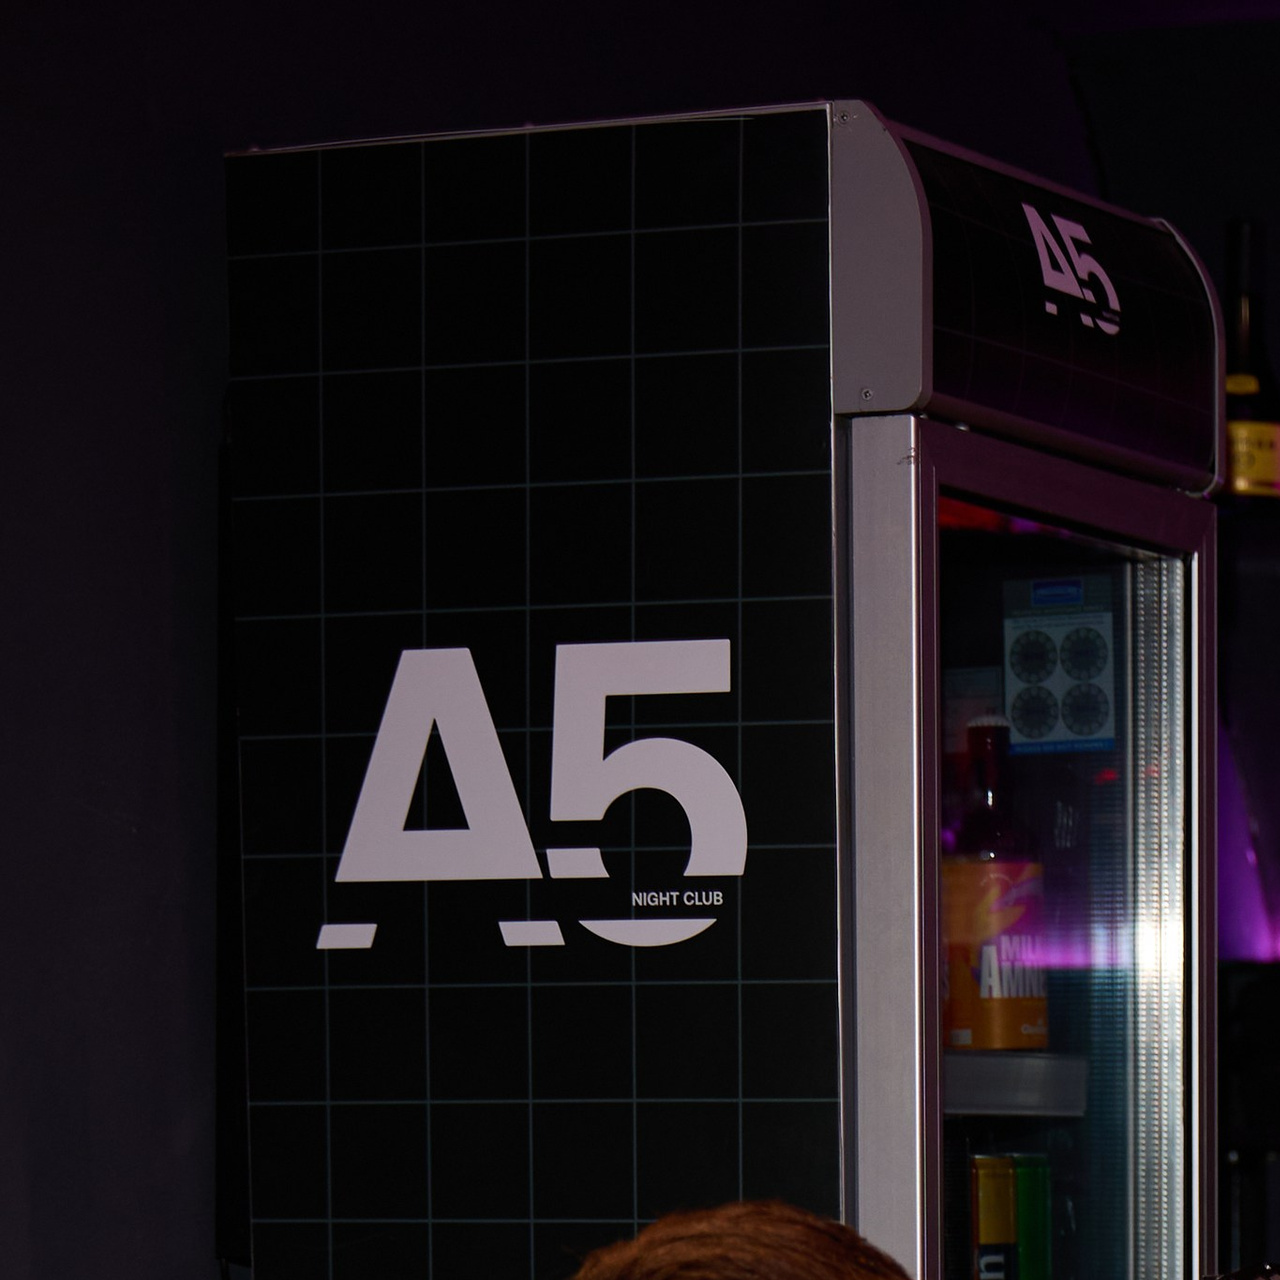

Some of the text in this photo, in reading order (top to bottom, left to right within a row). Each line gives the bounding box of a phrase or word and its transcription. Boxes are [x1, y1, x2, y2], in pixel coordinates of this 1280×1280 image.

[1020, 200, 1121, 336] A5
[316, 639, 748, 947] A5
[631, 890, 724, 907] NIGHT CLUB
